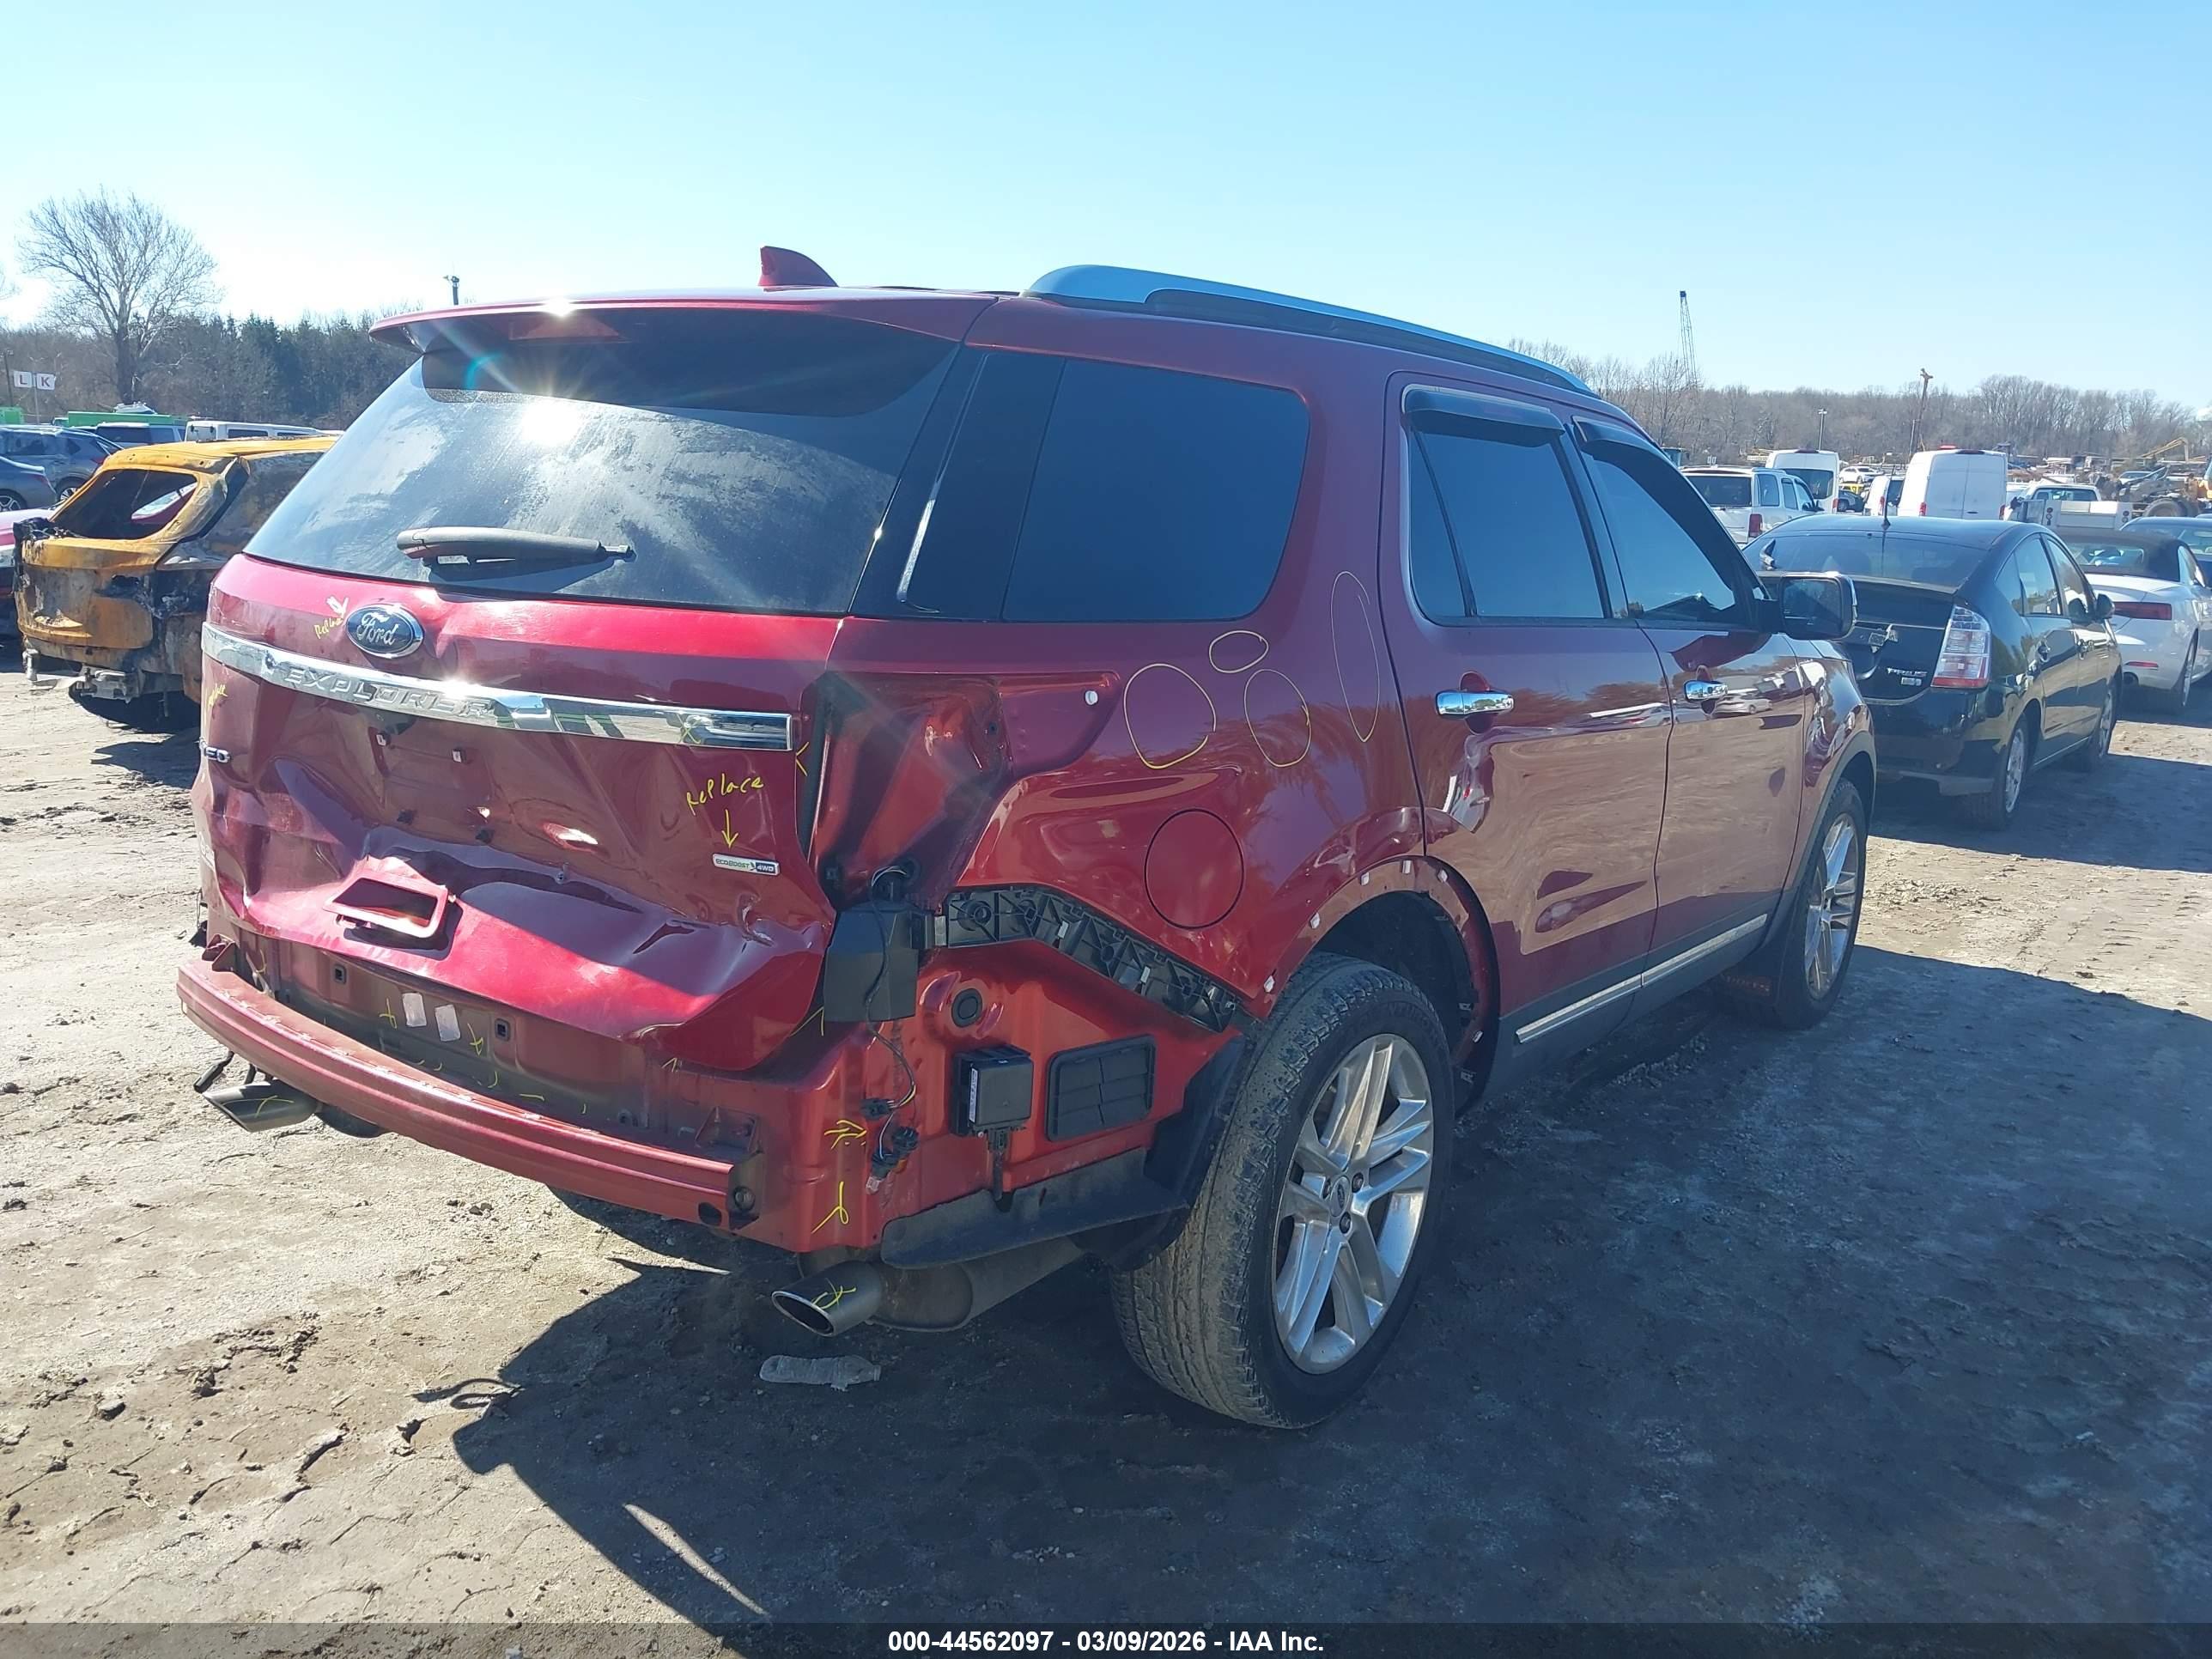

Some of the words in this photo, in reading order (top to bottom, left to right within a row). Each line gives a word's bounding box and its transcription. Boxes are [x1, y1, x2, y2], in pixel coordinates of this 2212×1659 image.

[20, 374, 27, 385] L
[40, 376, 50, 387] K
[356, 611, 399, 646] Ford
[284, 667, 493, 718] EXPLORER
